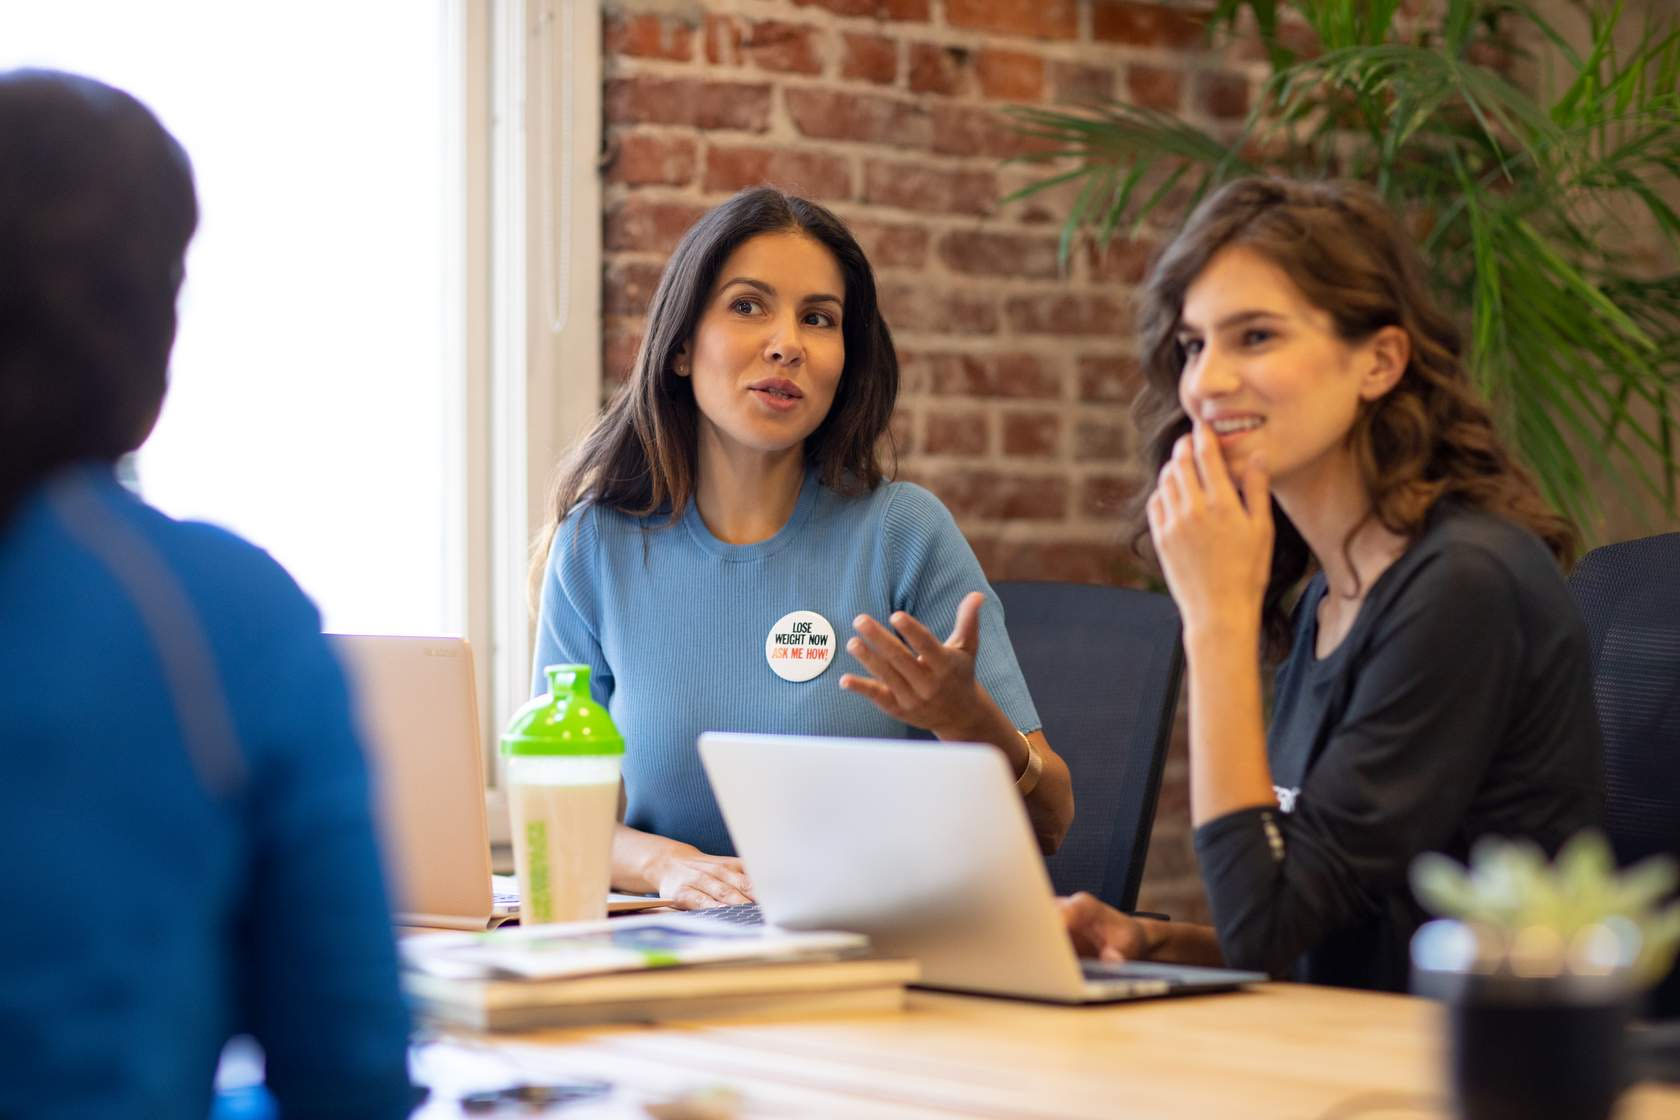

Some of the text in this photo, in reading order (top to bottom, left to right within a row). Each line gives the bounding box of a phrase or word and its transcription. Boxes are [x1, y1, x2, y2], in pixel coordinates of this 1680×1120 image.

[793, 622, 812, 633] LOSE
[775, 634, 828, 645] WEIGHT NOW
[772, 648, 829, 660] ASK ME HOW!
